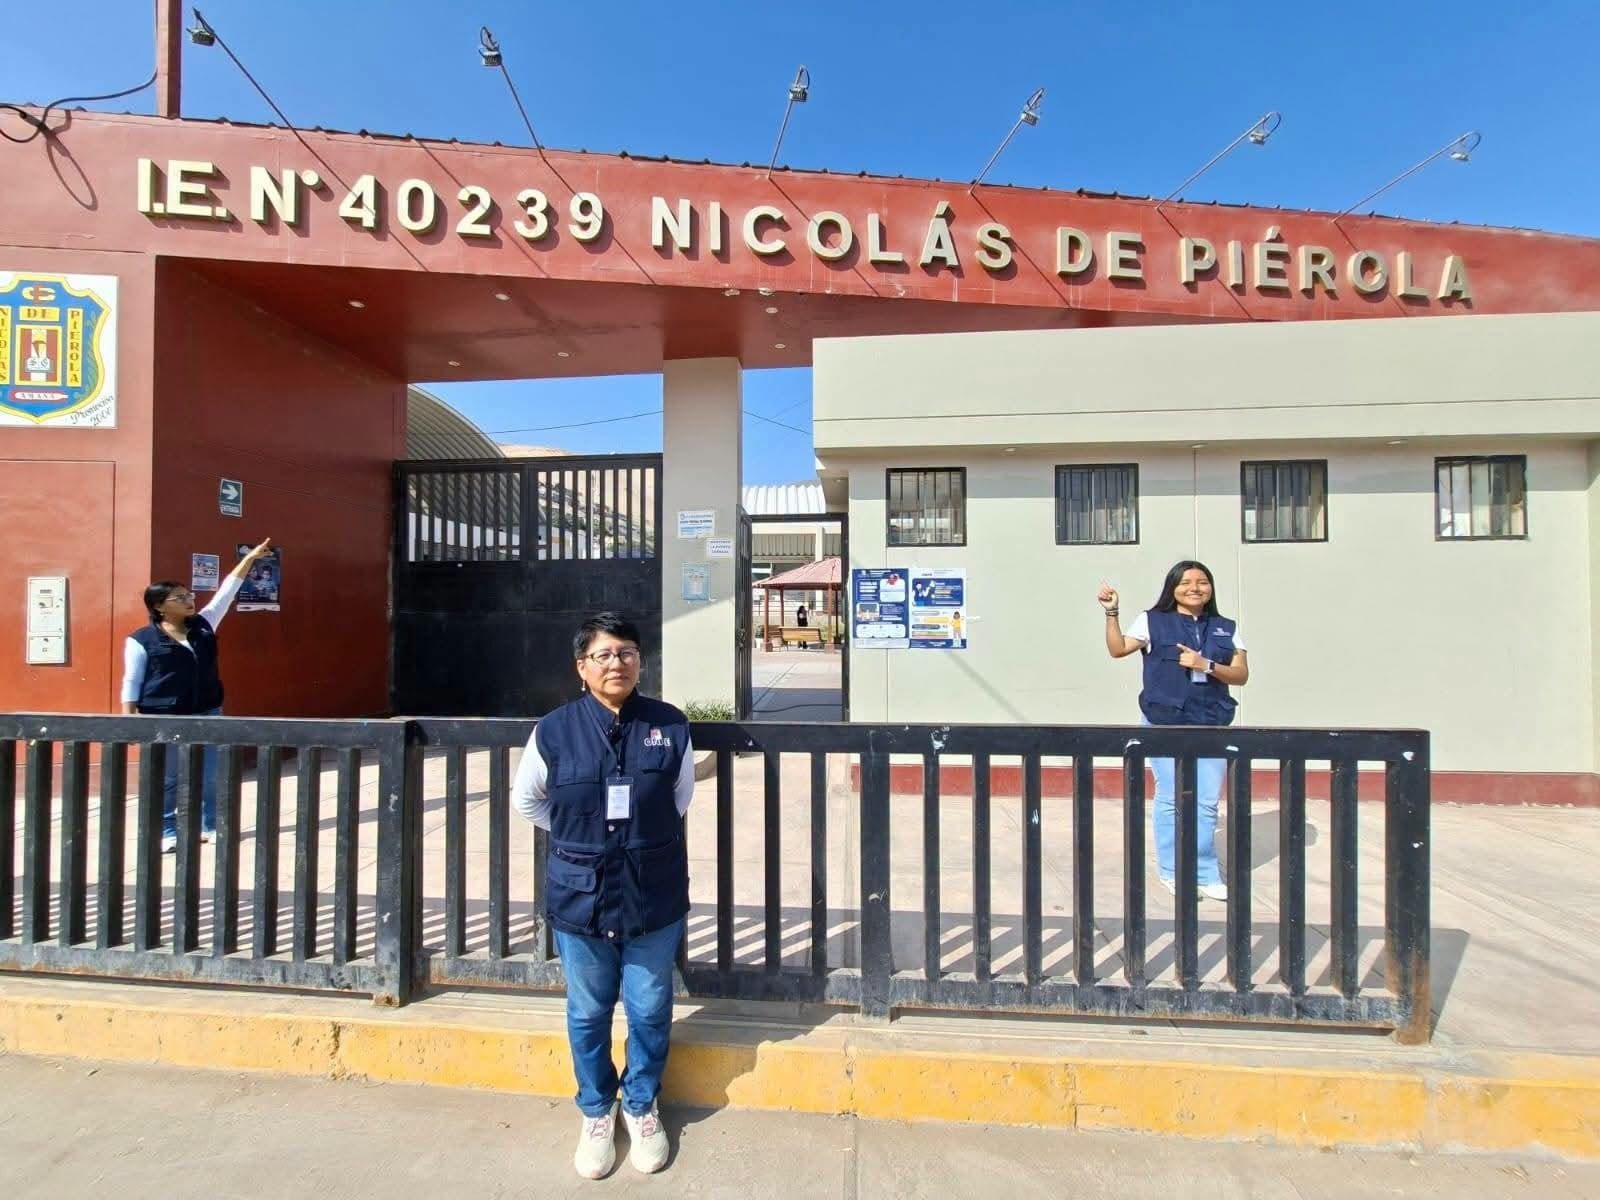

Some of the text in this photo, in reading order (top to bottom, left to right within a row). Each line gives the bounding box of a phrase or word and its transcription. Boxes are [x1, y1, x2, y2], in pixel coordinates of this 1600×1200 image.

[137, 158, 228, 218] I.E.
[338, 174, 604, 242] 40239
[651, 196, 1013, 273] NICOLÁS
[1056, 226, 1144, 281] DE
[1179, 225, 1472, 301] PIÉROLA
